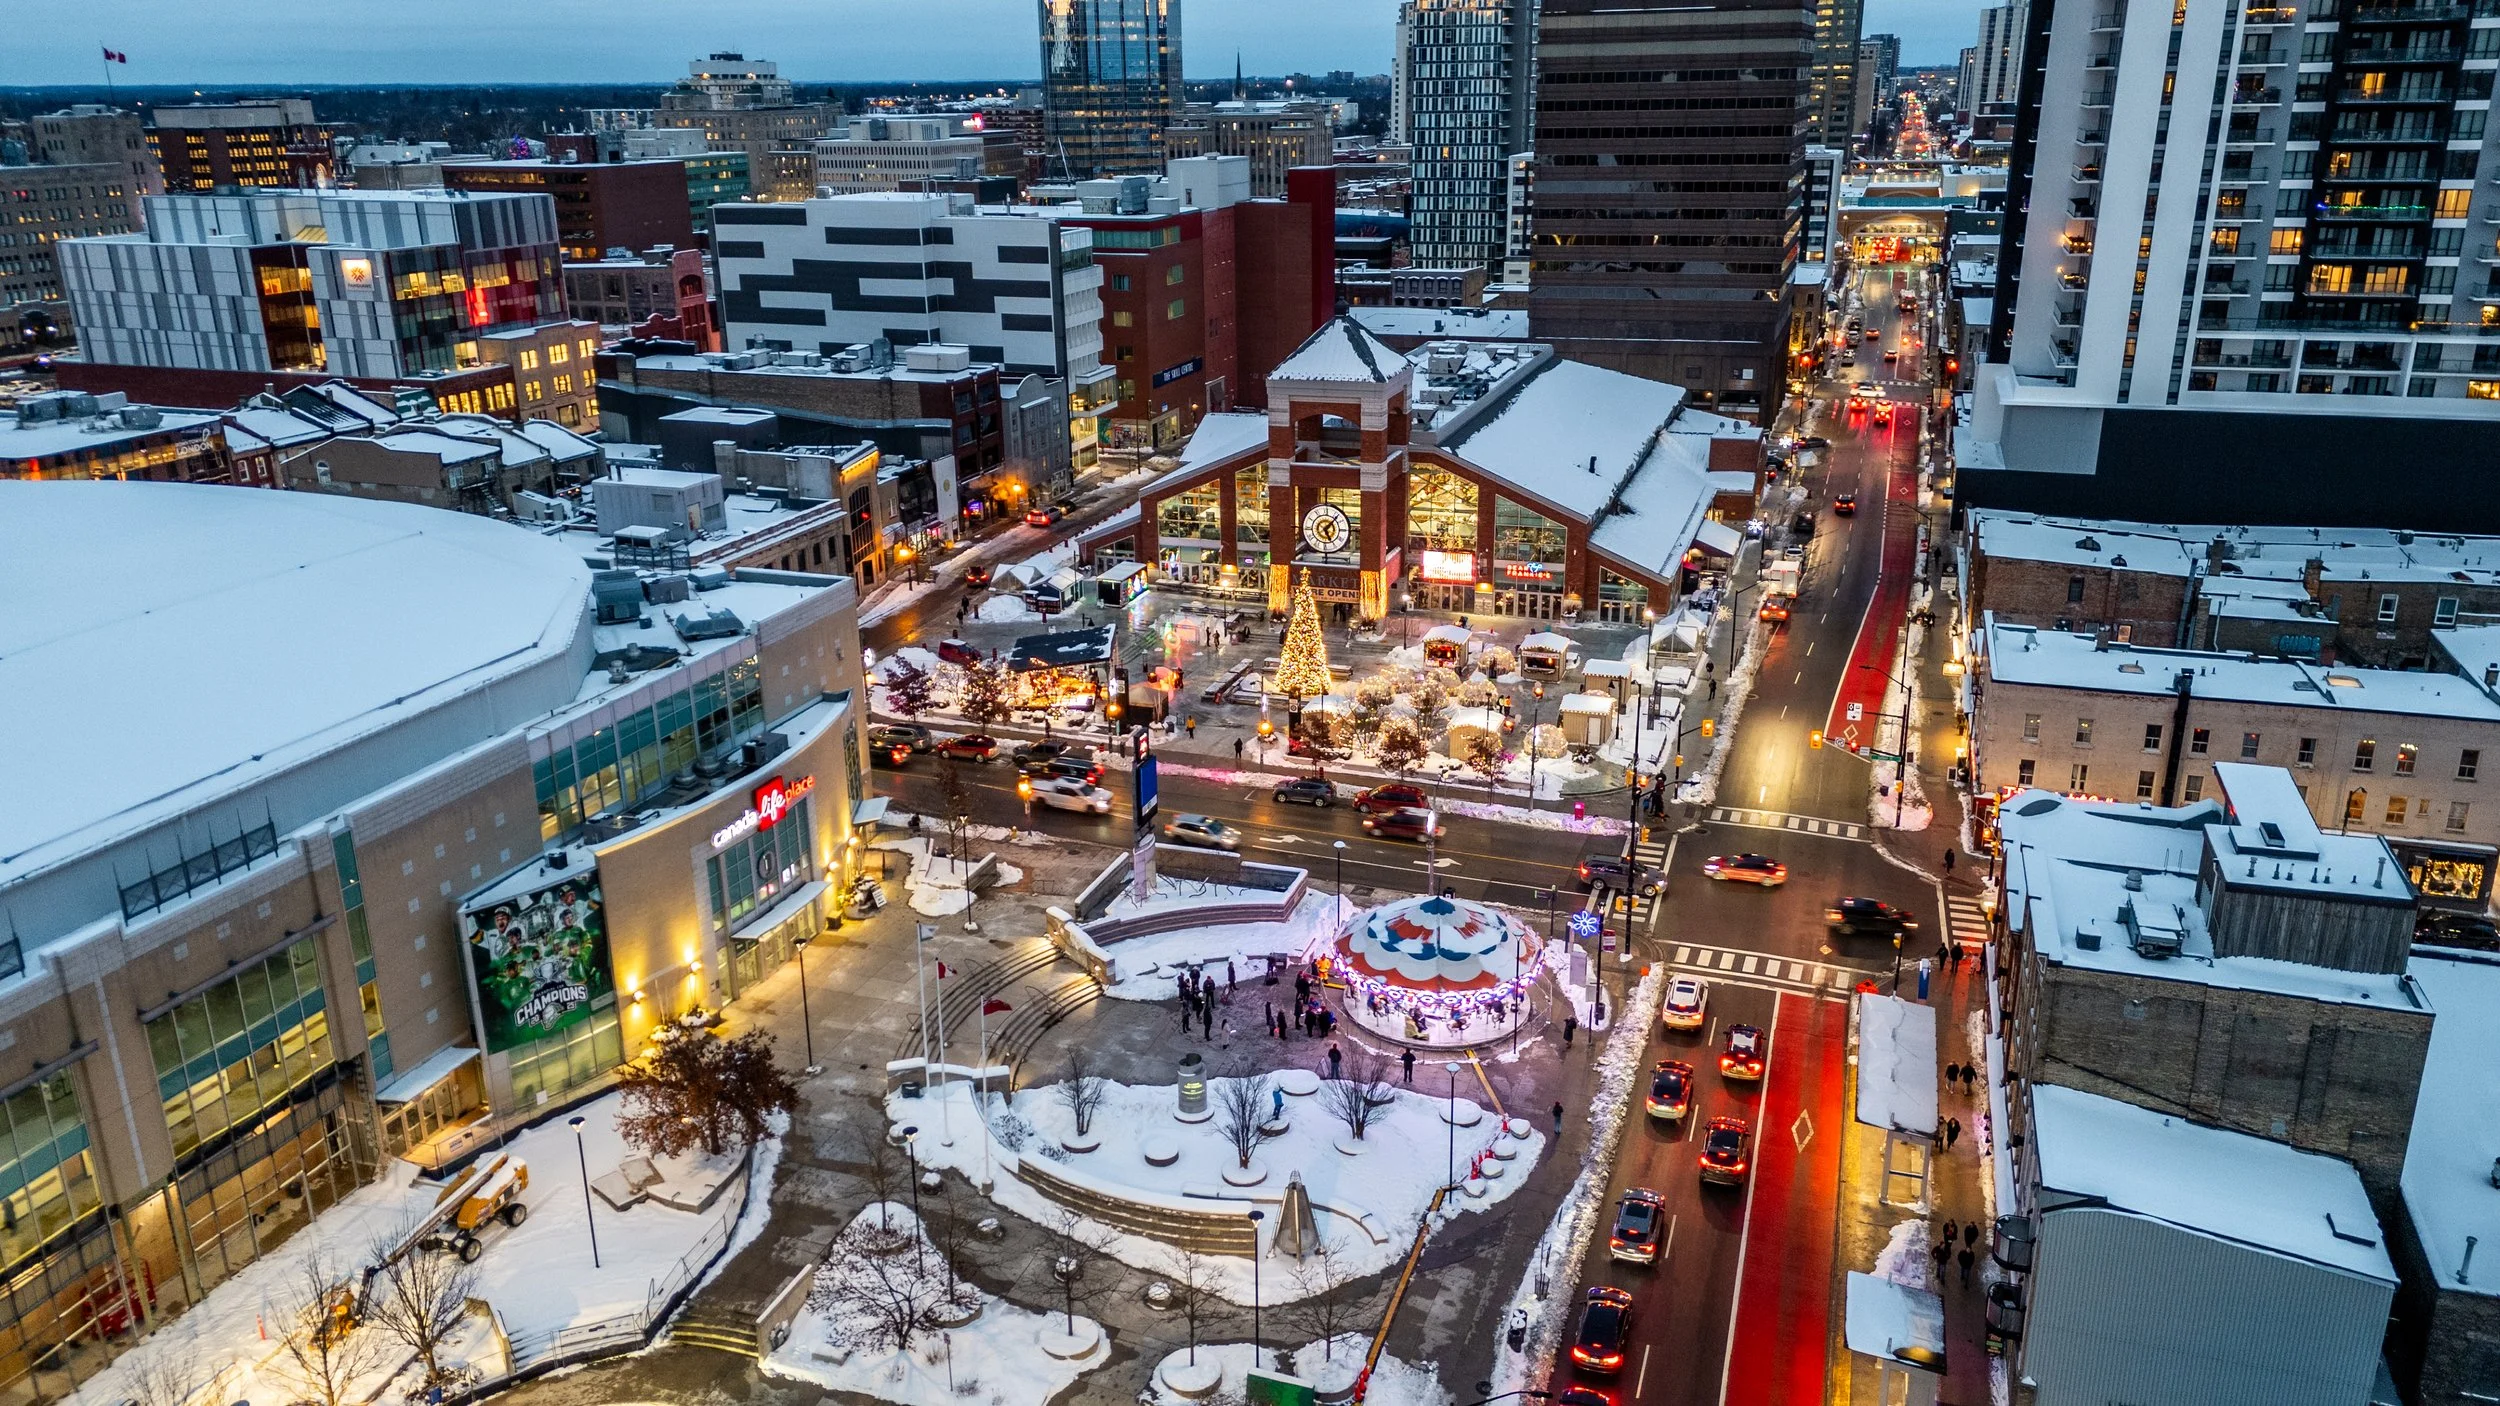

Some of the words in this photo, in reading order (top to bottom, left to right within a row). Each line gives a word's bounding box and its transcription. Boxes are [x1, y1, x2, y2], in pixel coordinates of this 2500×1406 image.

[176, 442, 213, 456] LONDON
[1327, 589, 1359, 599] OPEN!
[712, 809, 758, 848] canada
[759, 789, 786, 821] life
[785, 774, 815, 804] place
[516, 986, 586, 1025] CHAMPIONS
